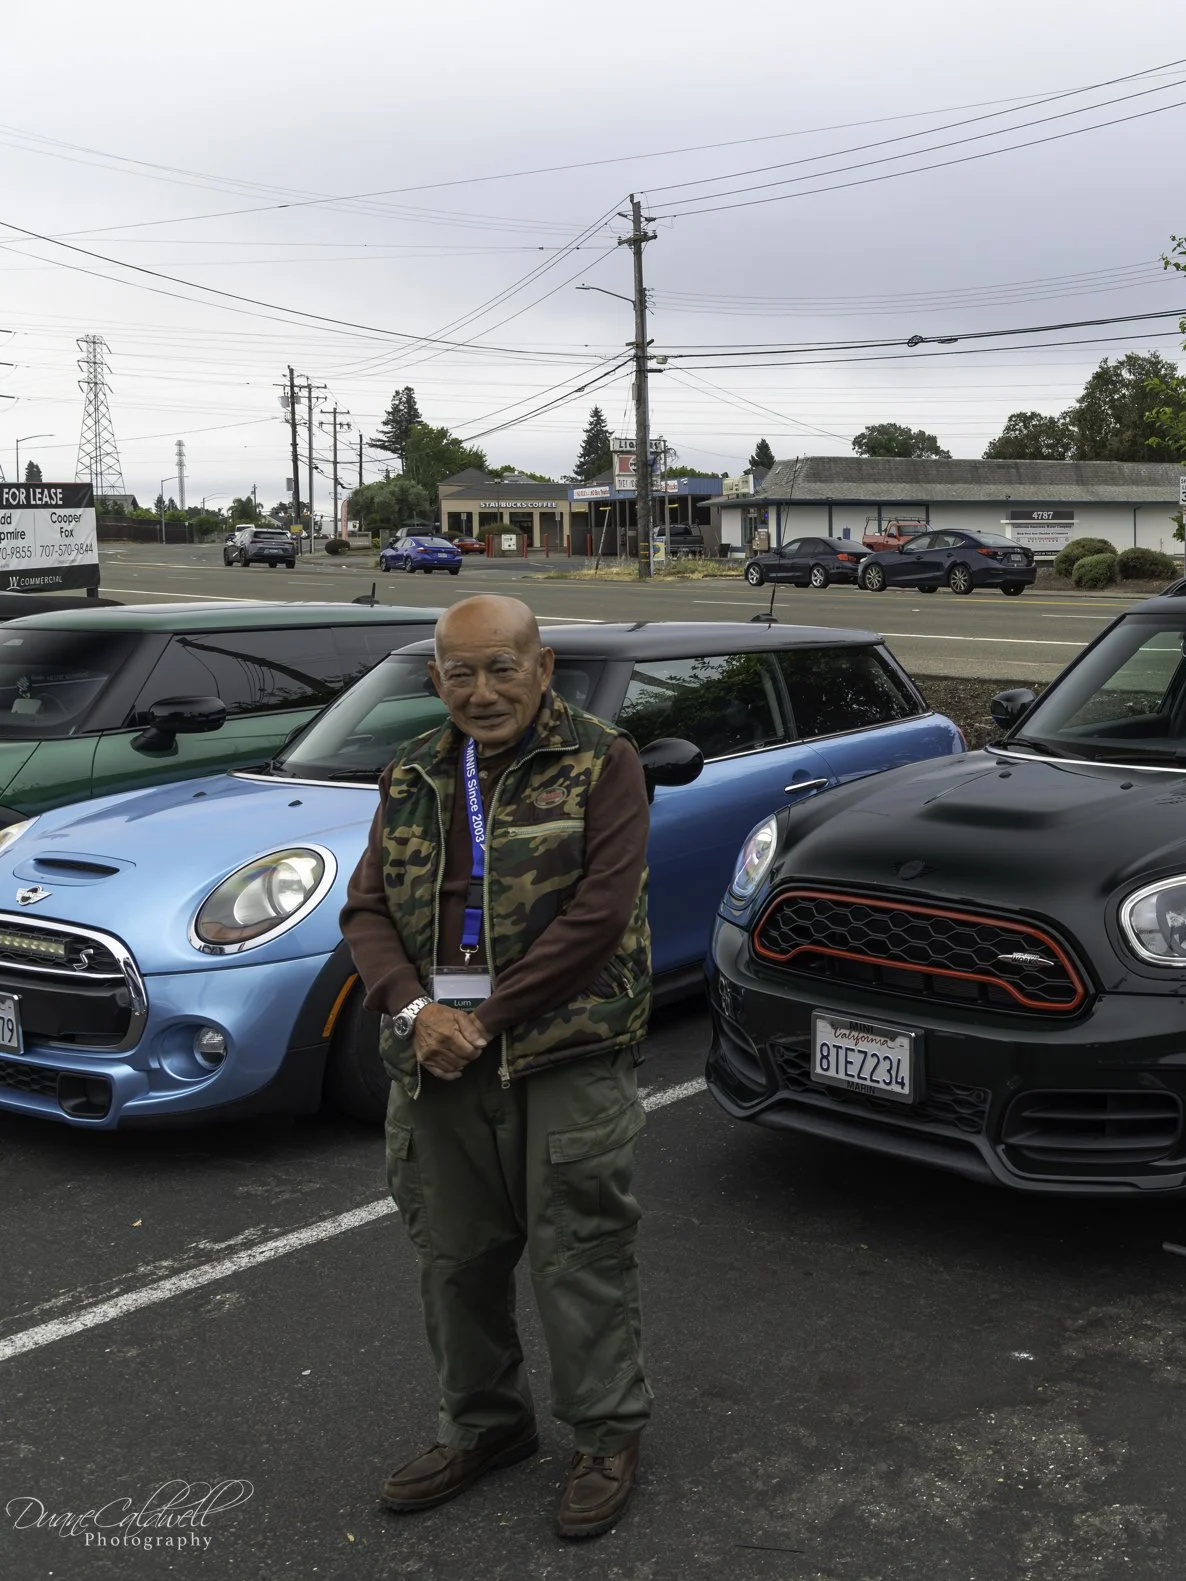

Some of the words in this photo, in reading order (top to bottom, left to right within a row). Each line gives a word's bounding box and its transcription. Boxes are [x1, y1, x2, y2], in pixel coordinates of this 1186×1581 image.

[3, 487, 27, 505] FOR
[30, 488, 63, 505] LEASE
[50, 511, 82, 526] Cooper
[1032, 511, 1054, 520] 4787
[60, 527, 74, 538] Fox
[39, 543, 94, 558] 707-570-9844
[20, 575, 63, 586] COMMERCIAL
[465, 745, 476, 778] MINIS
[467, 779, 479, 812] Since
[472, 814, 485, 843] 2003
[453, 999, 472, 1007] Lum
[848, 1020, 874, 1034] MINI
[833, 1027, 895, 1050] California
[819, 1041, 906, 1090] 8TEZ234
[846, 1080, 876, 1095] MARIN
